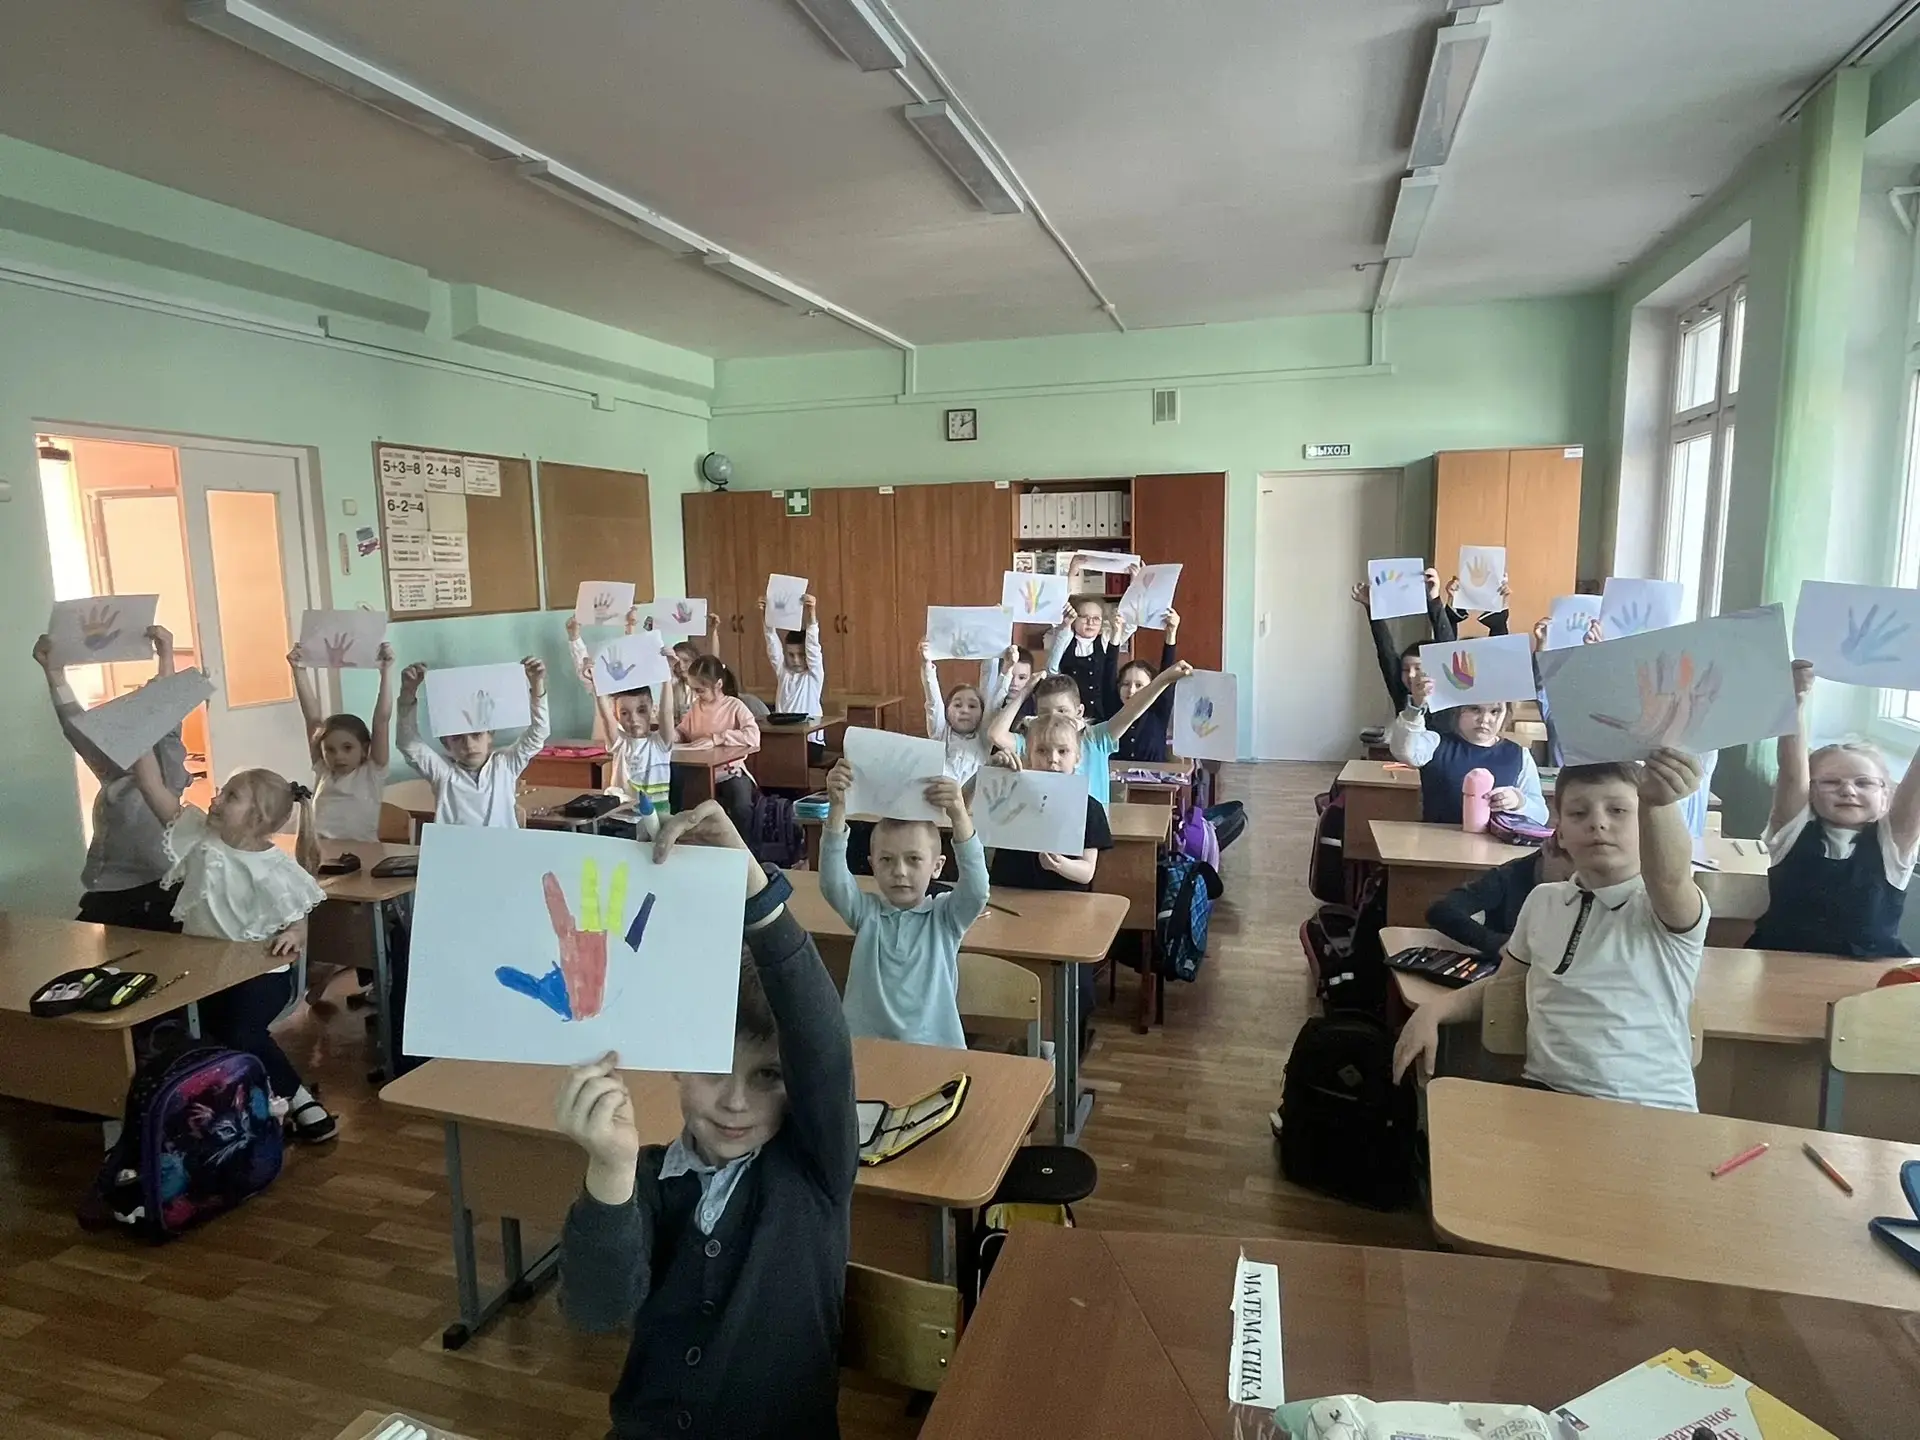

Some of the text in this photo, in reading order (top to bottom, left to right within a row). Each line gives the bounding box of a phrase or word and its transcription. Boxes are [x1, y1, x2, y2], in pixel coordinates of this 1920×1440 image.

[1310, 445, 1349, 456] ЫХОД
[382, 460, 421, 475] 5+3=8
[387, 499, 424, 513] 6-2=4
[1241, 1271, 1262, 1402] МАТЕМАТИКА
